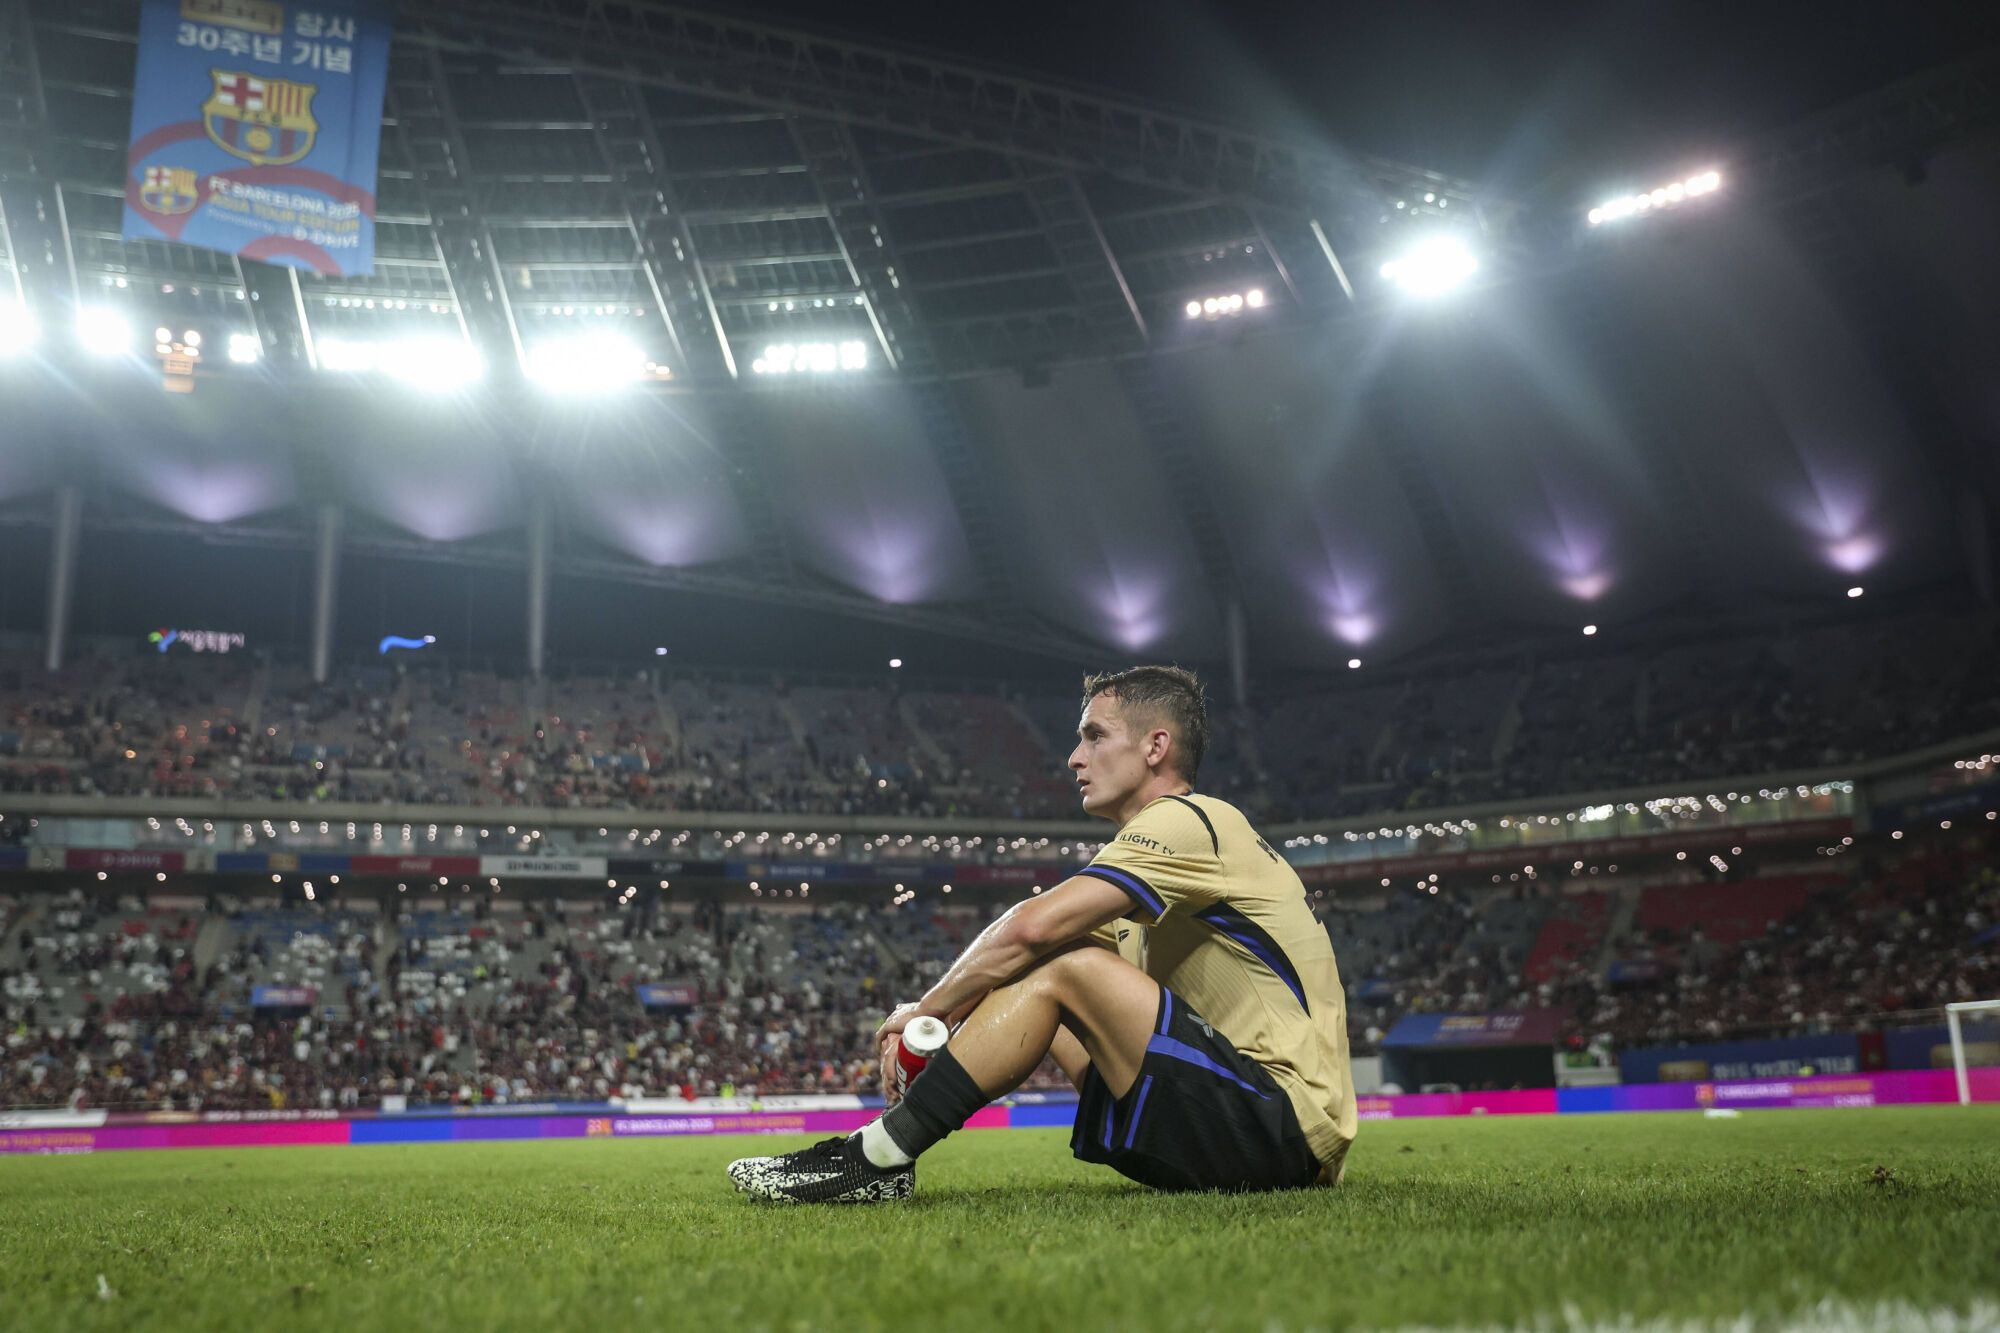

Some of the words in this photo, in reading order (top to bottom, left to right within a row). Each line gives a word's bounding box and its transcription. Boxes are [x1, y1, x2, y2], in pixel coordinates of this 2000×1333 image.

[177, 22, 282, 64] 30주년
[292, 40, 352, 74] 기념
[231, 182, 327, 212] BARCELONA
